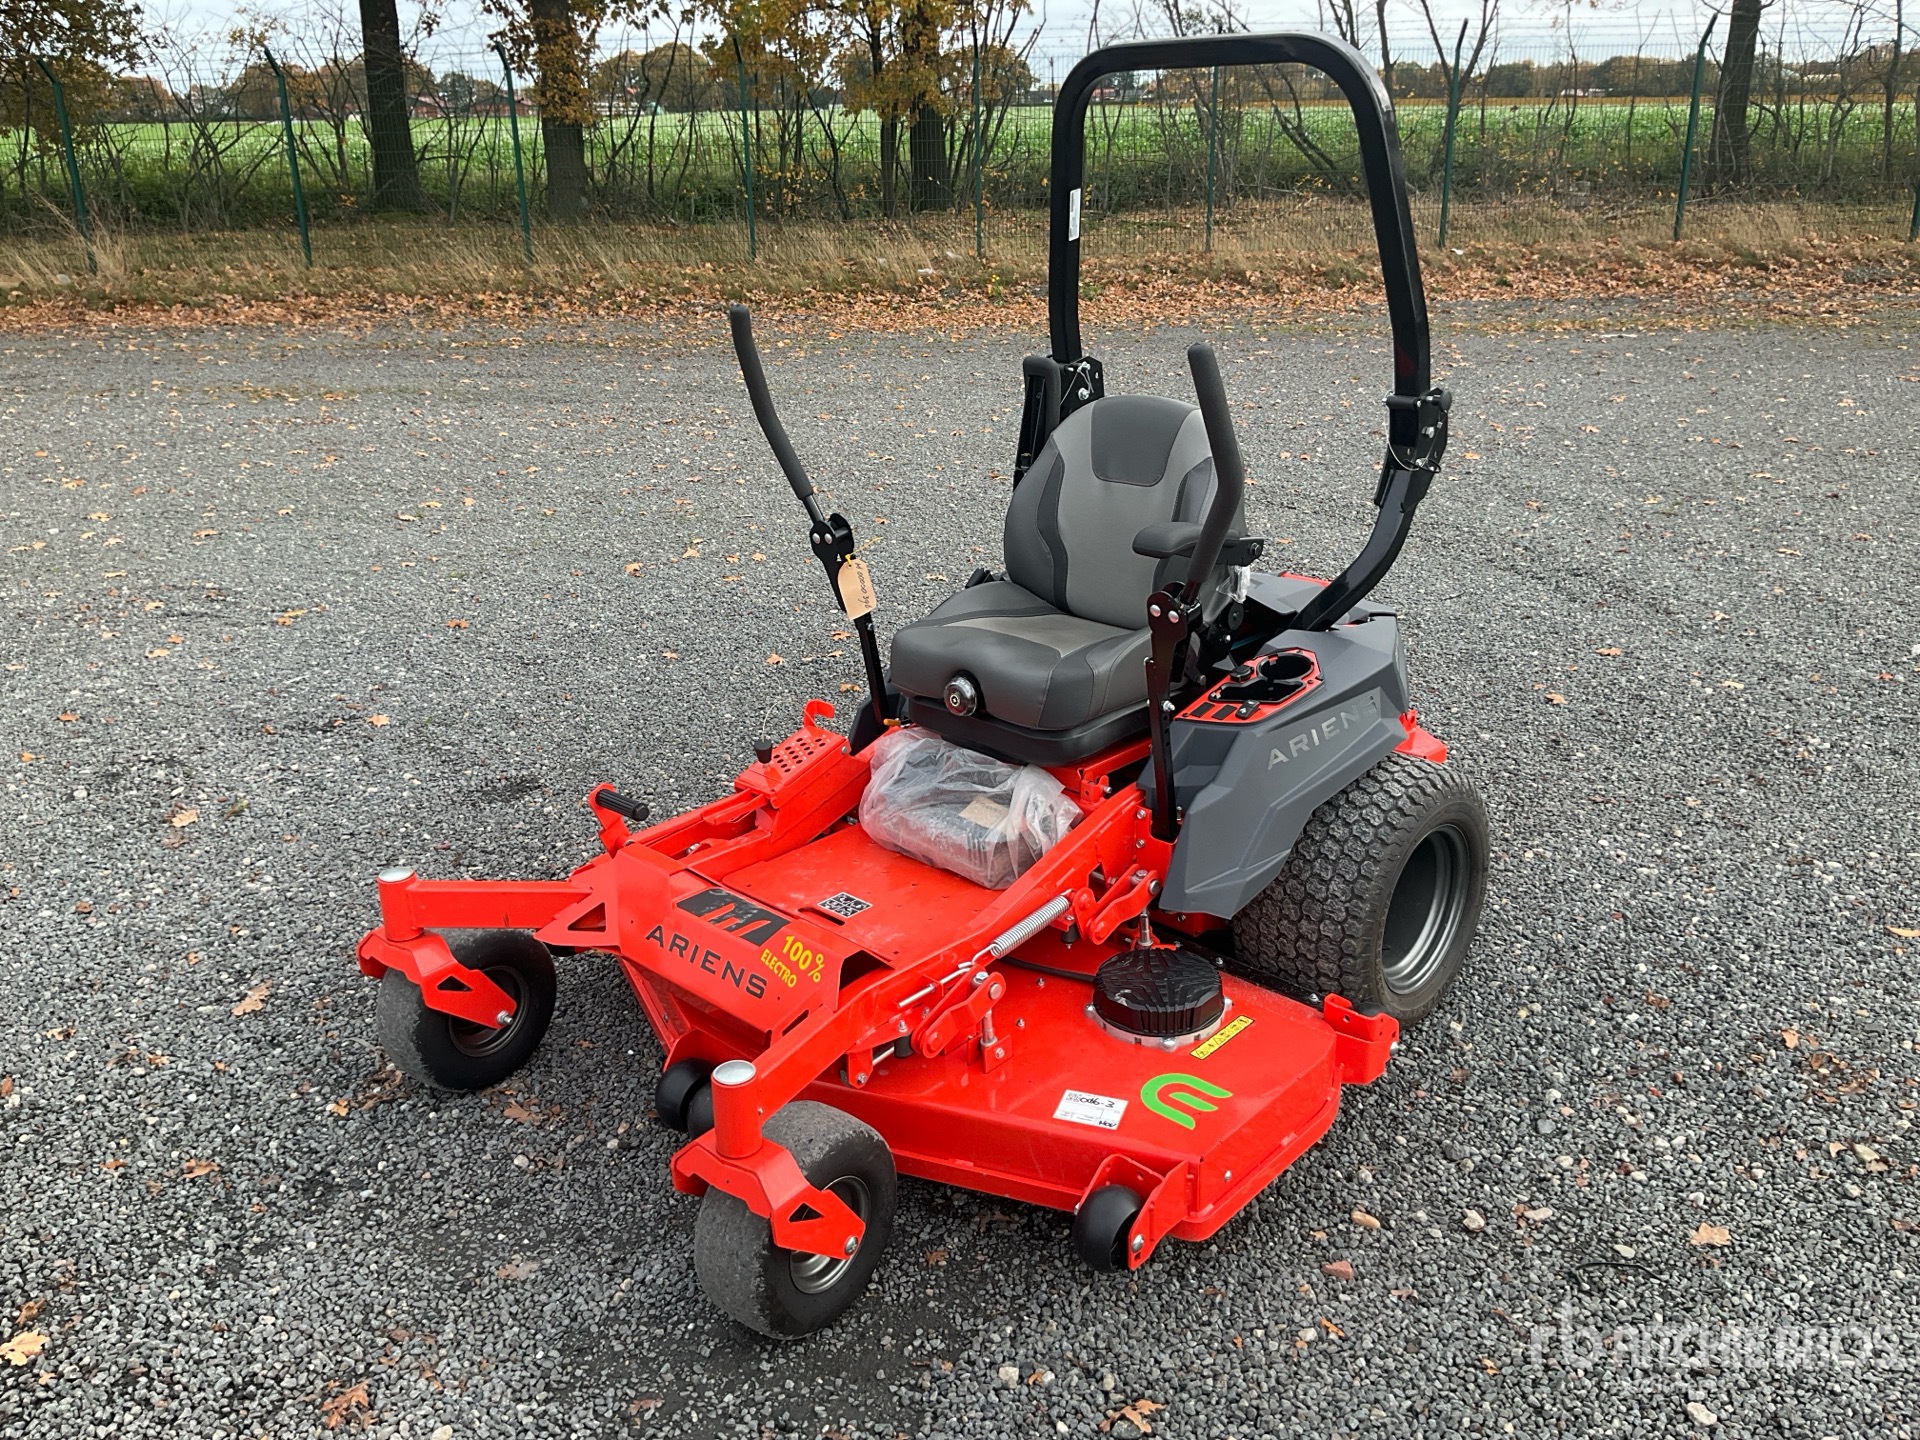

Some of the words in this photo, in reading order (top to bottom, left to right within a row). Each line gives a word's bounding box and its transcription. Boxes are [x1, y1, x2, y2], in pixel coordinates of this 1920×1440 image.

[645, 925, 768, 999] ARIENS
[760, 948, 798, 988] ELECTRO
[782, 935, 825, 984] 100%
